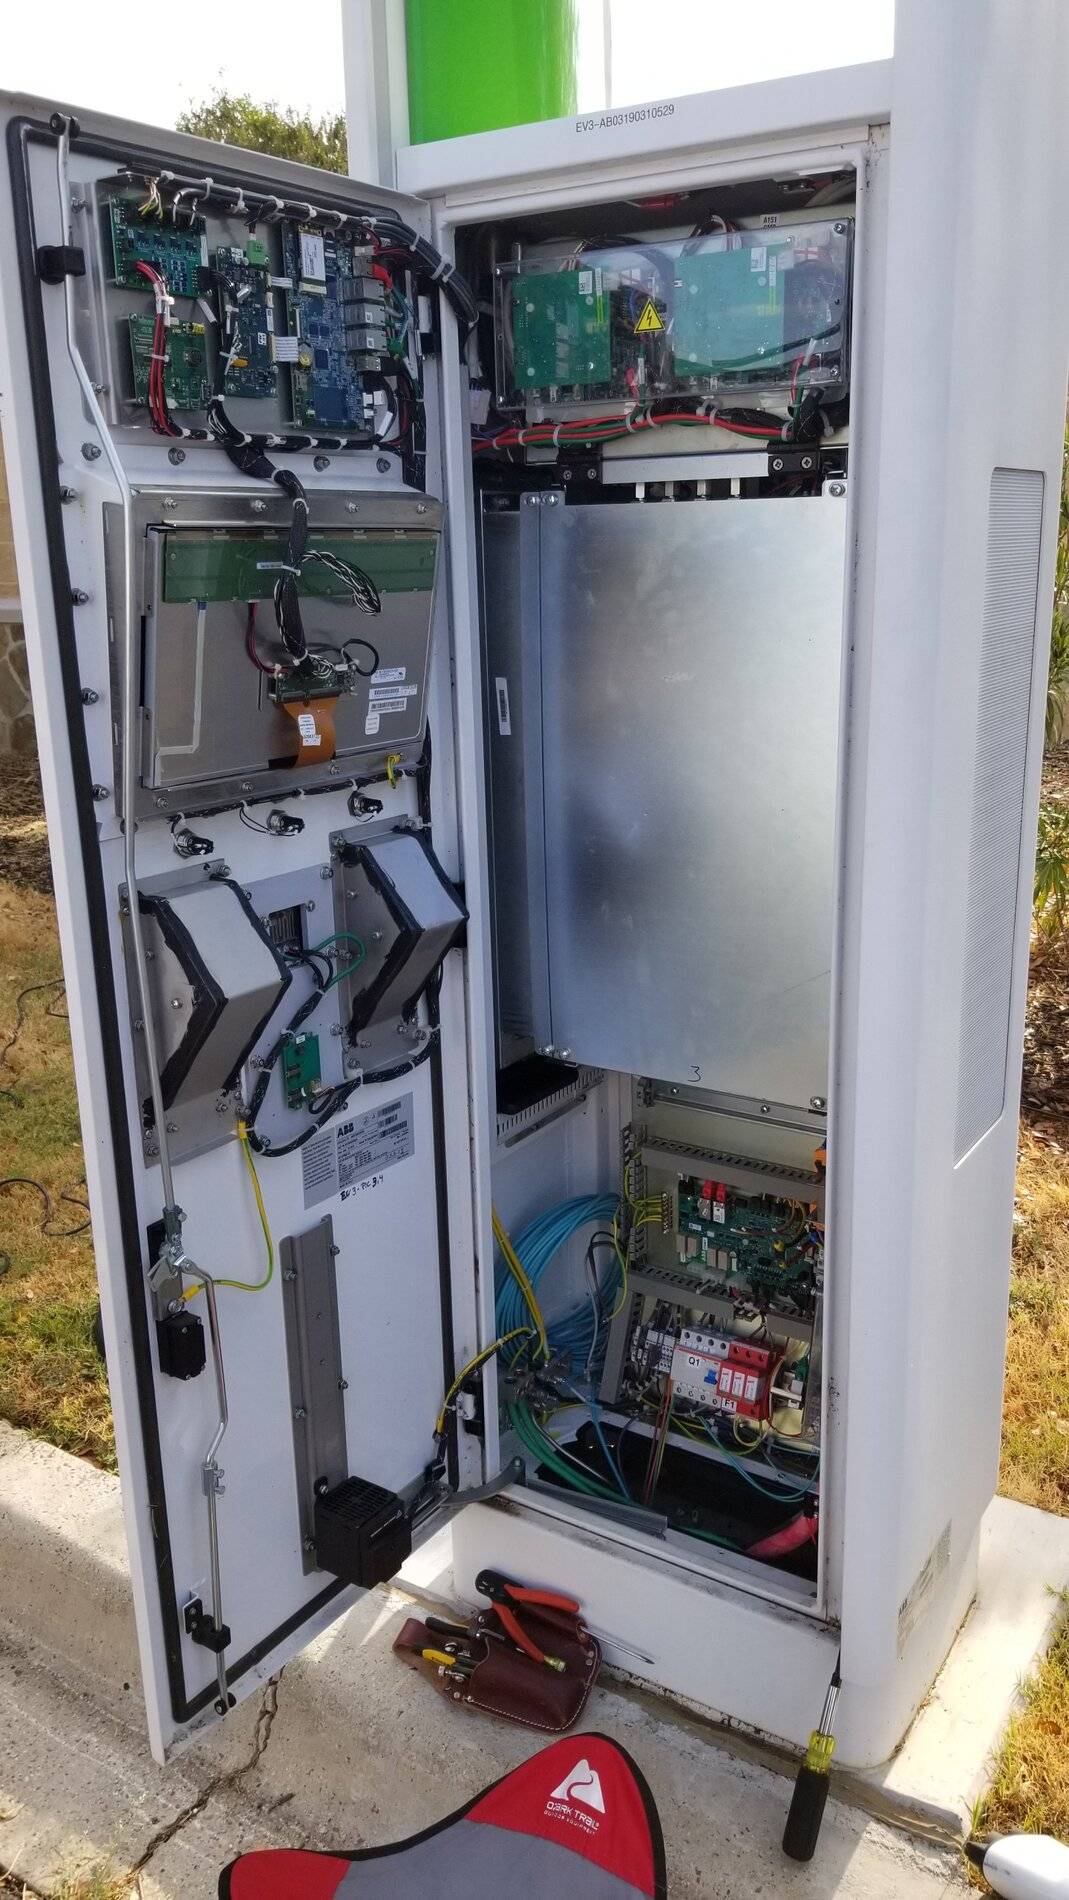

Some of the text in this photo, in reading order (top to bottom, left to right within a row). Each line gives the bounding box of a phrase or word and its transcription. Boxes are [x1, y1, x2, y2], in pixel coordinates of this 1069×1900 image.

[575, 104, 675, 132] EV3-AB03190310529
[687, 1065, 701, 1082] 3
[337, 1122, 354, 1138] ABB
[688, 1356, 700, 1366] Q1
[724, 1400, 735, 1409] F1
